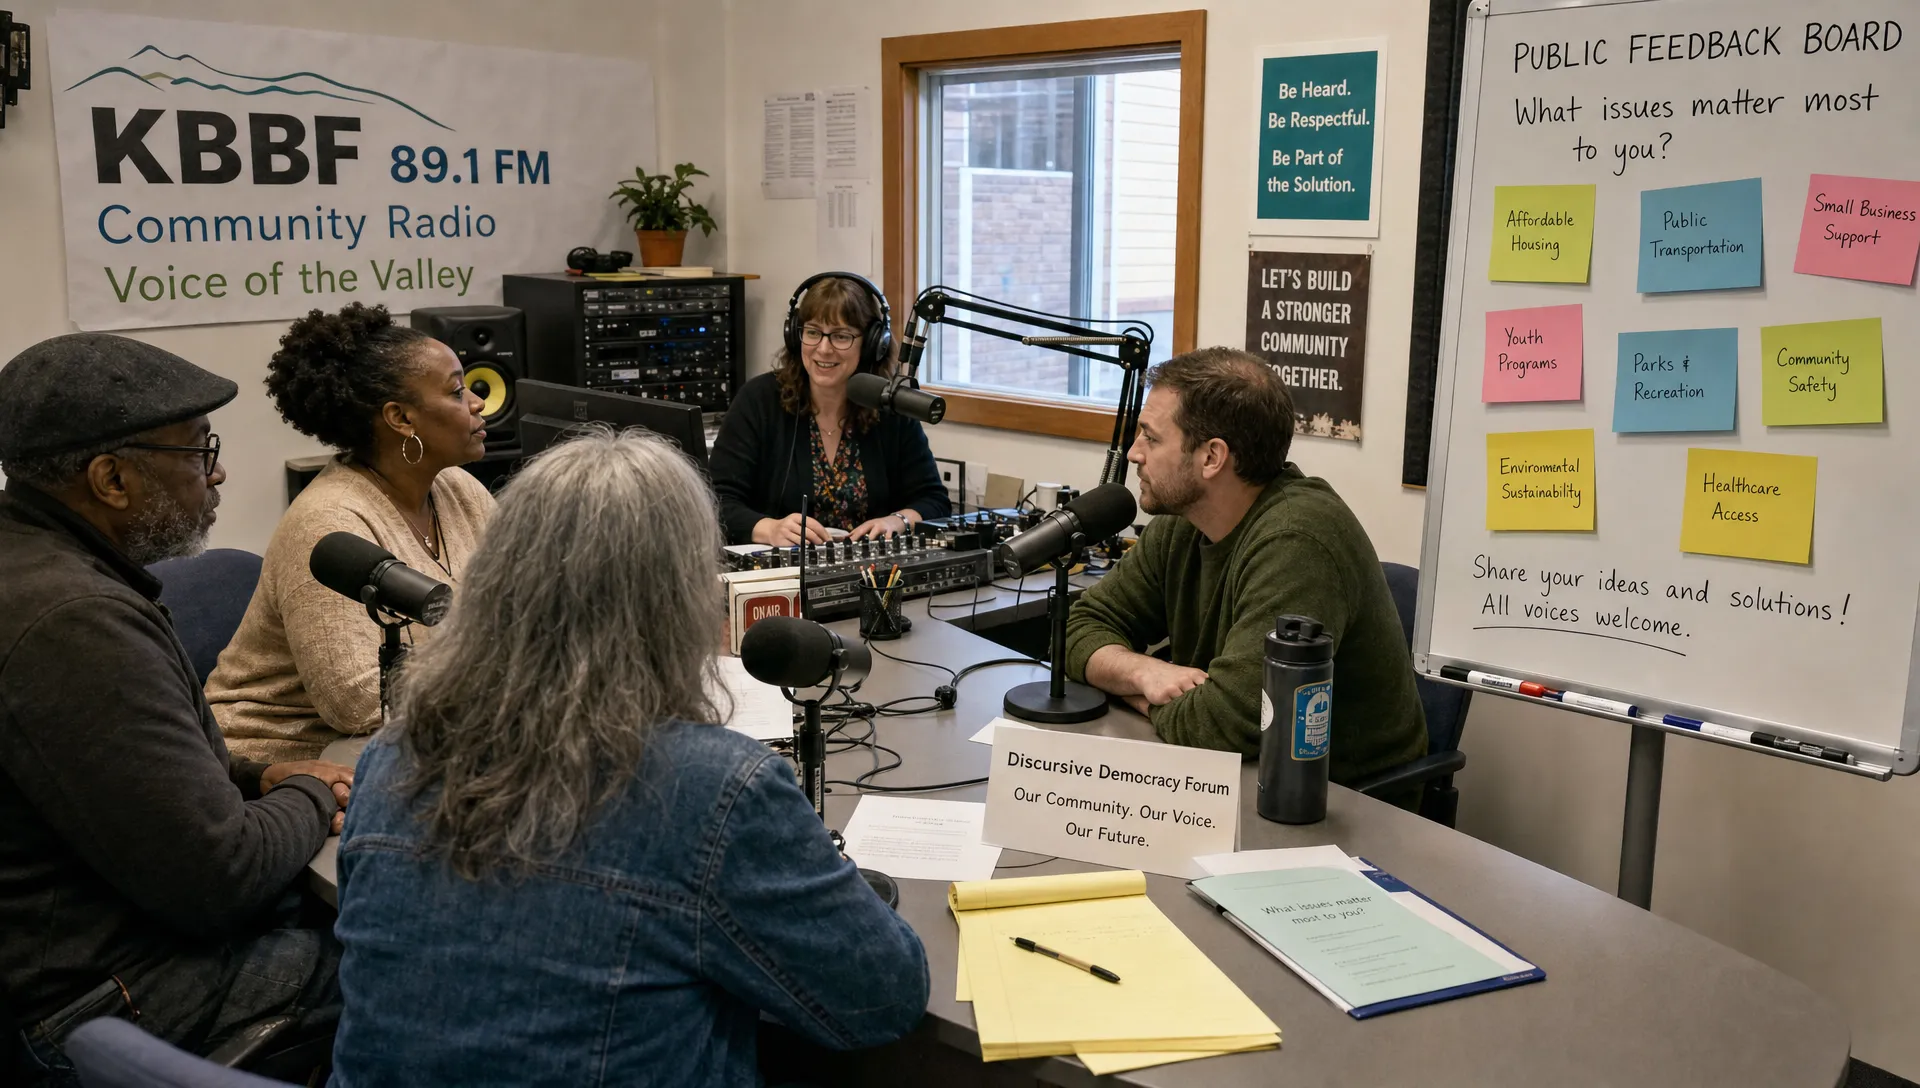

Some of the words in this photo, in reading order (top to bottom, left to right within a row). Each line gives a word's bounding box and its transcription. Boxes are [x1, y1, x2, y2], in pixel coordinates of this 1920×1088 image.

[1514, 39, 1608, 74] PUBLIC
[1630, 26, 1781, 64] FEEDBACK
[1803, 20, 1902, 54] BOARD
[1279, 83, 1297, 100] Be
[1302, 79, 1351, 98] Heard.
[1515, 96, 1582, 125] What
[1603, 98, 1674, 120] issues
[1692, 89, 1785, 117] matter
[1805, 83, 1879, 113] most
[1268, 113, 1286, 129] Be
[1290, 109, 1370, 131] Respectful.
[91, 106, 362, 185] KBBF
[390, 145, 479, 184] 89.1
[496, 149, 550, 184] FM
[1273, 150, 1290, 166] Be
[1295, 149, 1324, 165] Part
[1328, 148, 1344, 165] of
[1572, 135, 1598, 162] to
[1614, 132, 1673, 176] you?
[1267, 176, 1289, 193] the
[1294, 176, 1355, 193] Solution.
[1506, 211, 1574, 227] Affordable
[1813, 193, 1853, 215] Small
[1860, 200, 1916, 222] Business
[98, 204, 366, 250] Community
[388, 204, 496, 239] Radio
[1663, 211, 1707, 229] Public
[1511, 235, 1560, 260] Housing
[1824, 224, 1881, 248] Support
[1650, 240, 1744, 261] Transportation
[104, 264, 227, 302] Voice
[244, 261, 283, 296] of
[298, 260, 358, 294] the
[370, 258, 474, 297] Valley
[1308, 269, 1351, 291] BUILD
[1261, 300, 1271, 320] A
[1276, 301, 1351, 324] STRONGER
[1261, 331, 1348, 358] COMMUNITY
[1505, 327, 1543, 345] Youth
[1499, 354, 1558, 378] Programs
[1634, 353, 1674, 373] Parks
[1777, 347, 1850, 375] Community
[1265, 363, 1343, 391] GETHER.
[1789, 376, 1837, 401] Safety
[1634, 382, 1705, 400] Recreation
[1502, 482, 1581, 508] Sustainability
[1703, 473, 1781, 496] Healthcare
[1711, 502, 1759, 523] Access
[1473, 554, 1528, 582] Share
[1540, 571, 1584, 597] your
[1598, 569, 1649, 596] ideas
[1666, 579, 1709, 603] and
[1481, 594, 1509, 617] All
[1524, 600, 1580, 624] voices
[1596, 609, 1691, 638] welcome.
[1007, 751, 1093, 778] Discursive
[1099, 764, 1181, 793] Democracy
[1185, 776, 1230, 796] Forum
[1014, 787, 1041, 804] Our
[1046, 792, 1133, 818] Community.
[1140, 805, 1168, 821] Our
[1172, 809, 1216, 829] Voice.
[1065, 822, 1093, 838] Our
[1098, 826, 1150, 847] Future.
[1261, 905, 1295, 915] What
[1298, 901, 1334, 911] issues
[1336, 895, 1373, 906] matter
[1292, 915, 1322, 925] most
[1339, 908, 1366, 919] you?
